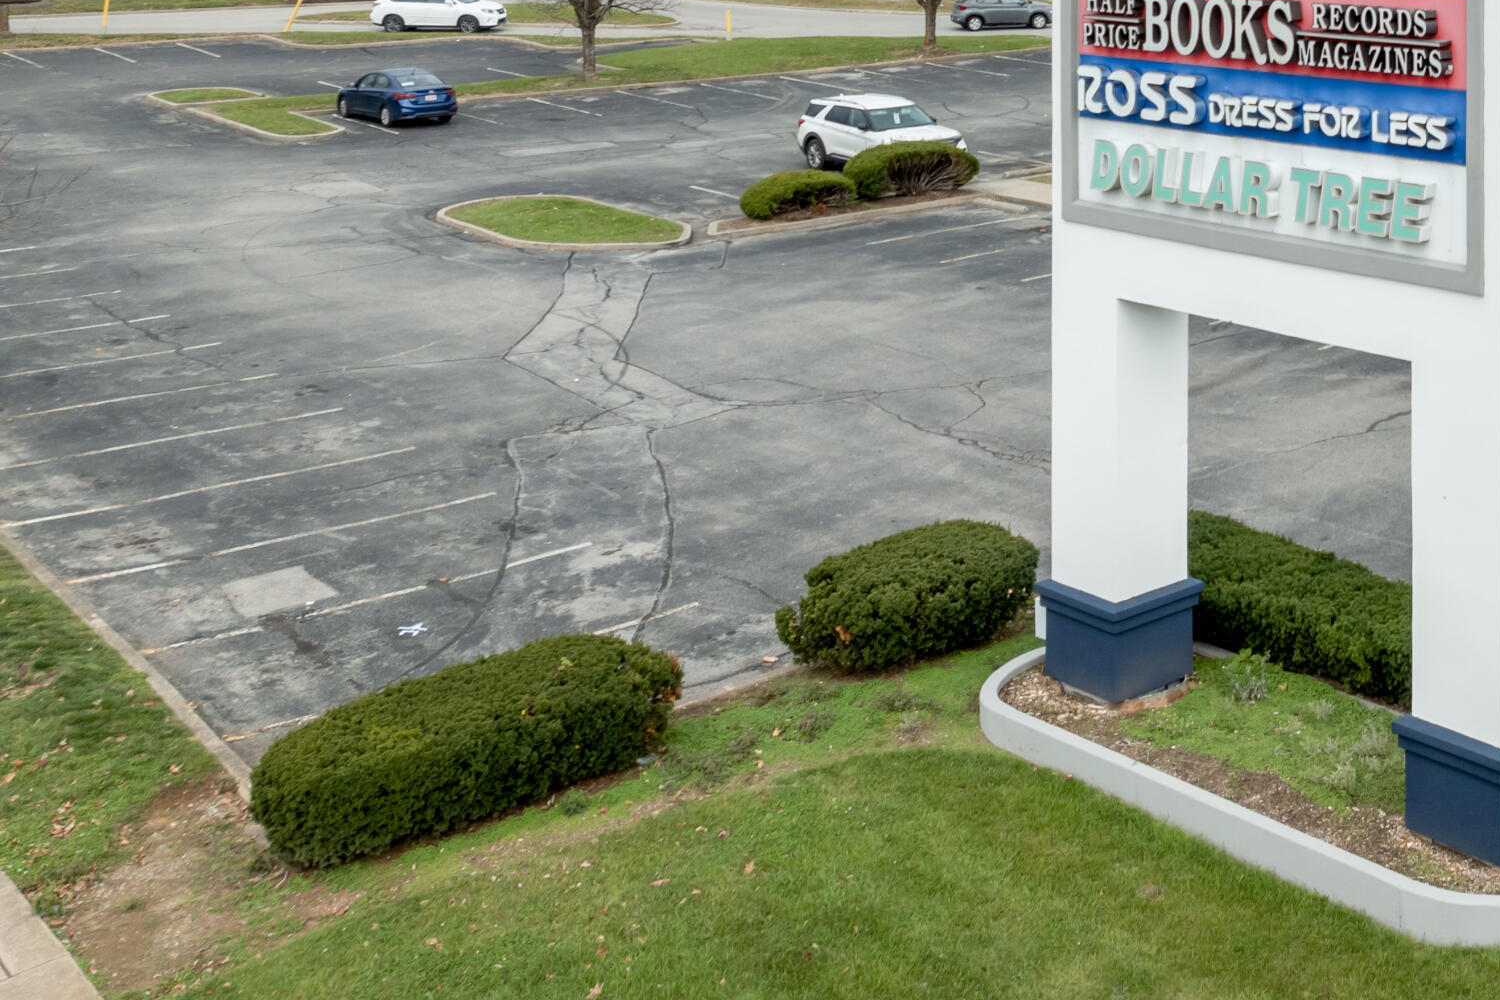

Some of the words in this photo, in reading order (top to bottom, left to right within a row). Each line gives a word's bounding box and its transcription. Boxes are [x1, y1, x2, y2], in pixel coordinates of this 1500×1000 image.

[1083, 22, 1143, 50] PRICE
[1312, 3, 1432, 38] RECORDS
[1297, 38, 1444, 78] MAGAZINES
[1077, 64, 1203, 126] ROSS
[1208, 93, 1297, 132] DRESS
[1302, 103, 1366, 140] FOR
[1371, 108, 1453, 151] LESS
[1090, 138, 1277, 219] DOLLAR
[1290, 166, 1436, 243] TREE
